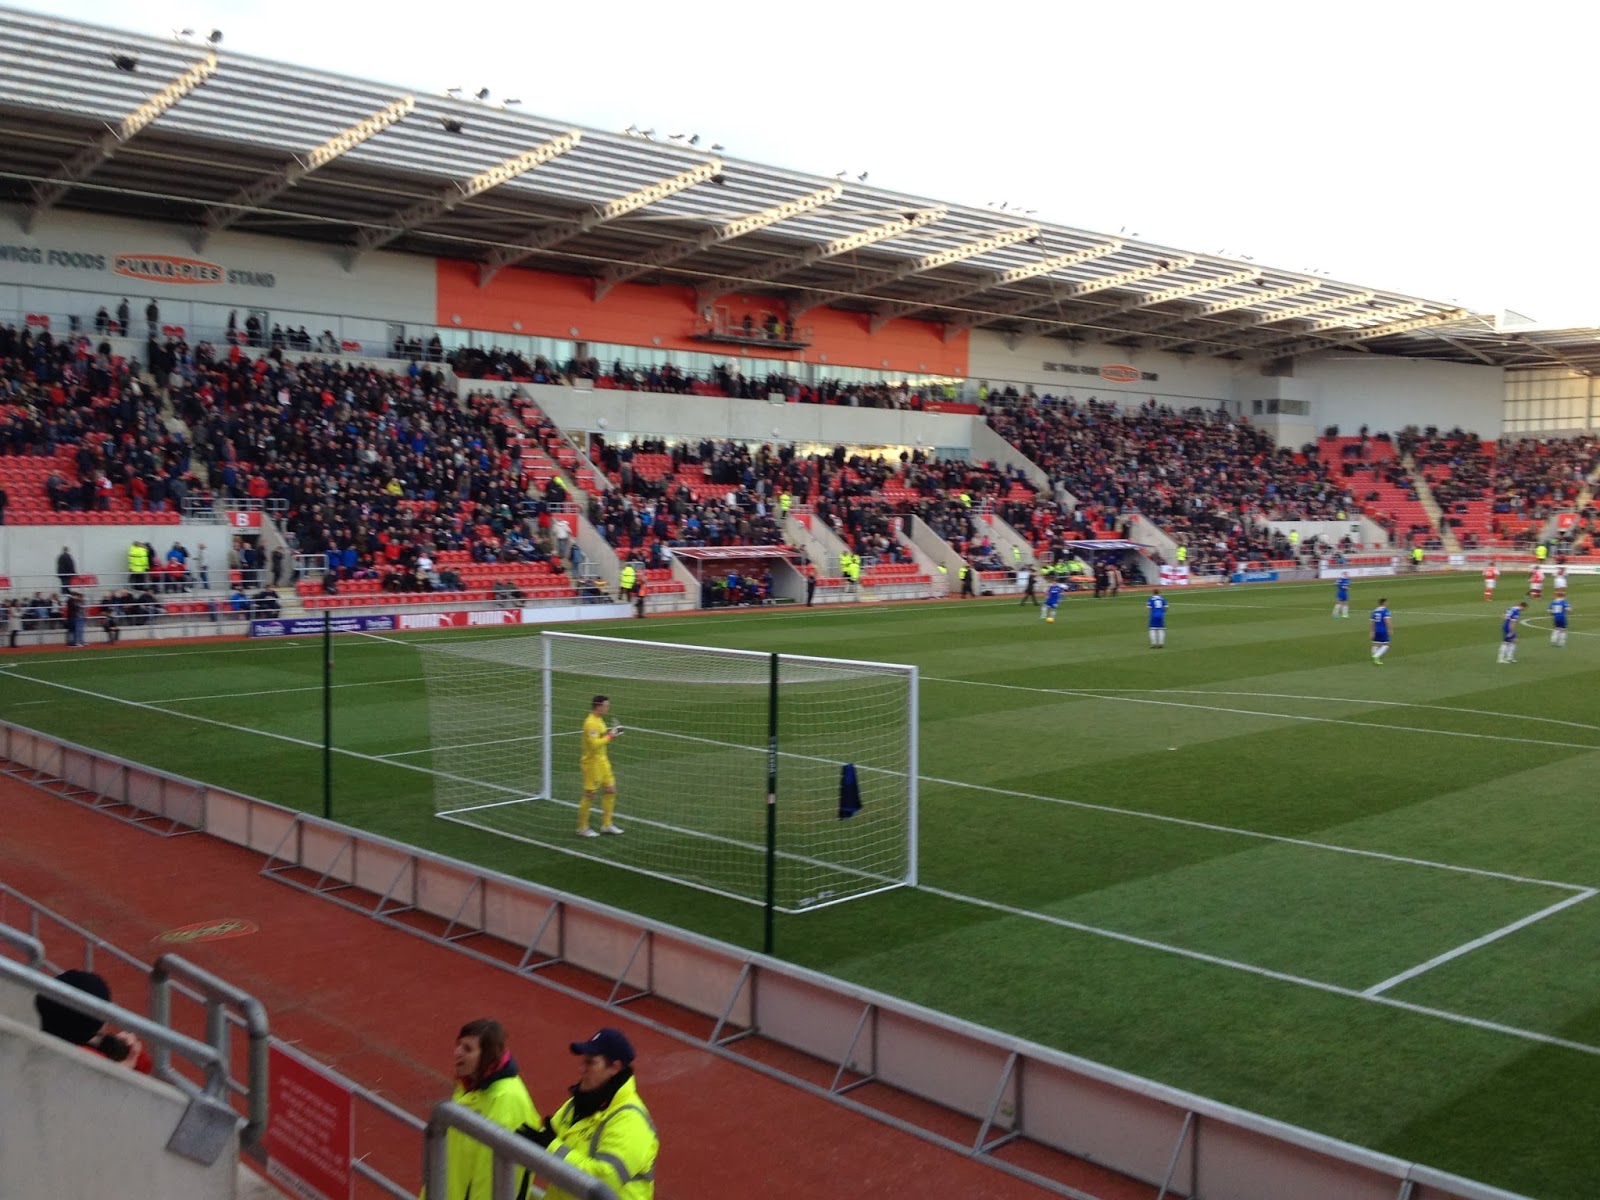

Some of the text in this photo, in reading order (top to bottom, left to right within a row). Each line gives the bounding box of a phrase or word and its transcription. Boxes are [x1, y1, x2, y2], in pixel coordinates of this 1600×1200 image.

[48, 249, 106, 271] FOODS
[227, 269, 276, 288] STAND
[236, 513, 250, 526] B
